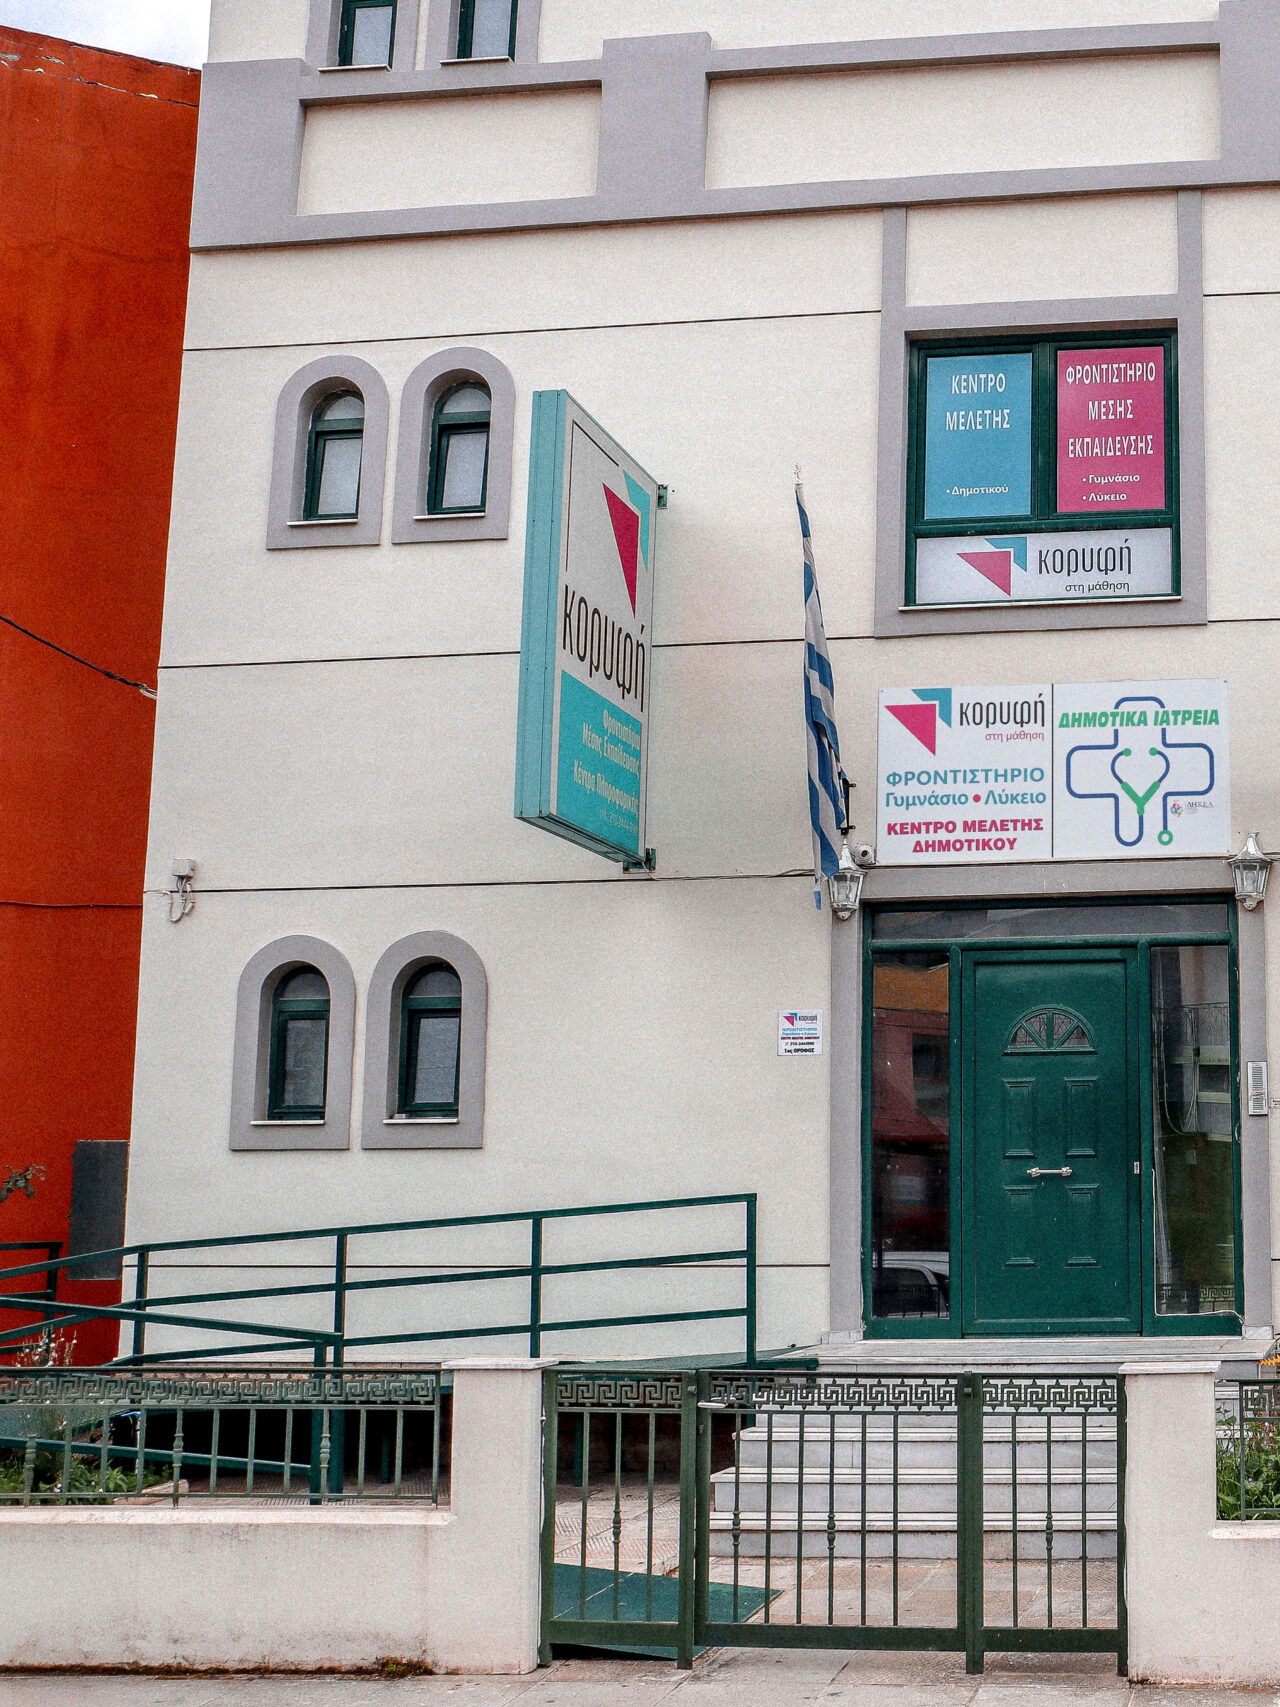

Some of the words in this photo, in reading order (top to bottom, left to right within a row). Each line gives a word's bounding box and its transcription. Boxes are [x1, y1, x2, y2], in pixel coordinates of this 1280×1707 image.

[1065, 361, 1156, 385] ΦΡΟΝΤΙΣΤΗΡΙΟ
[951, 372, 1006, 395] ΚΕΝΤΡΟ
[945, 409, 1011, 431] ΜΕΛΕΤΗΣ
[1088, 399, 1134, 421] ΜΕΣΗΣ
[1068, 434, 1154, 458] ΕΚΠΑΙΔΕΥΣΗΣ
[951, 483, 1009, 497] Δημοτικού
[1088, 473, 1141, 487] Γυμνάσιο
[1088, 491, 1127, 502] Λύκειο
[1038, 538, 1132, 577] κορυφή
[1064, 583, 1085, 594] στη
[1087, 580, 1130, 594] μάθηση
[562, 583, 646, 713] κορυφή
[959, 693, 1045, 728] κορυφή
[1058, 710, 1148, 728] ΔΗΜΟΤΙΚΑ
[1153, 709, 1220, 727] ΙΑΤΡΕΙΑ
[985, 733, 1003, 743] στη
[1006, 730, 1045, 742] μάθηση
[886, 767, 1045, 787] ΦΡΟΝΤΙΣΤΗΡΙΟ
[885, 790, 969, 810] Γυμνάσιο
[984, 789, 1047, 805] Λύκειο
[887, 820, 957, 836] ΚΕΝΤΡΟ
[962, 818, 1044, 833] ΜΕΛΕΤΗΣ
[912, 837, 1018, 853] ΔΗΜΟΤΙΚΟΥ
